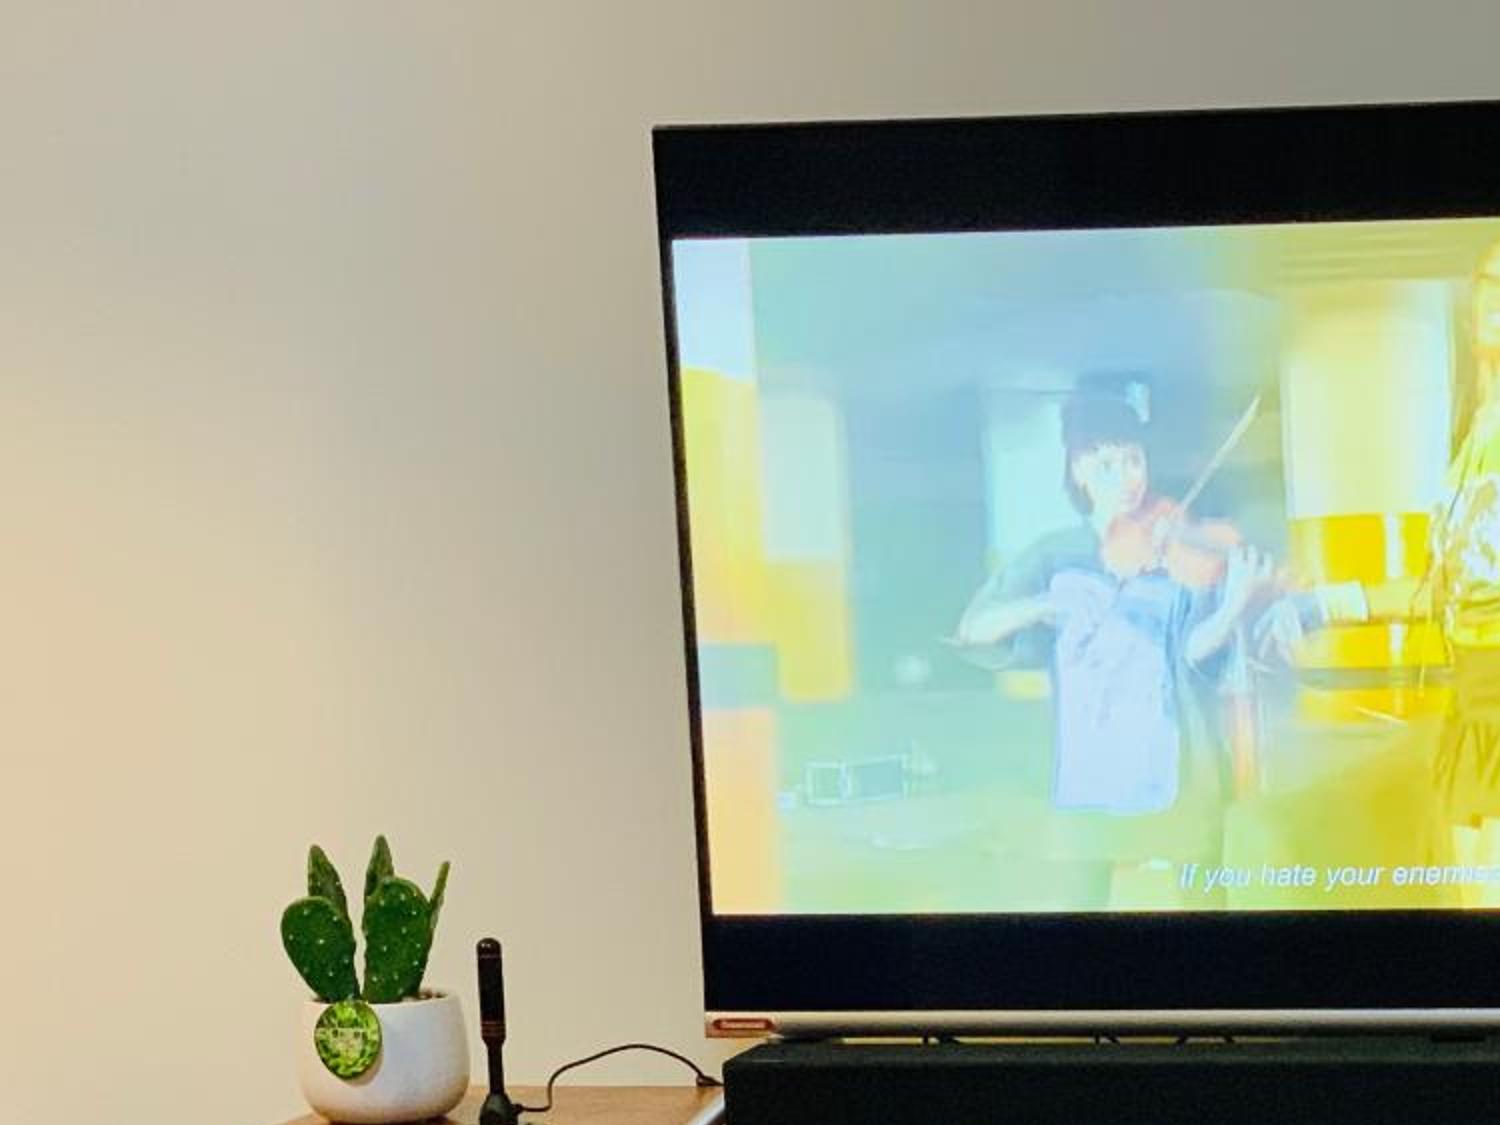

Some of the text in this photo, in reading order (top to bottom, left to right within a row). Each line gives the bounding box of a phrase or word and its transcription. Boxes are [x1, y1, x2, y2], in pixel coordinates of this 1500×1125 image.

[1203, 866, 1250, 894] you
[1261, 862, 1316, 886] hate
[1324, 864, 1384, 892] your
